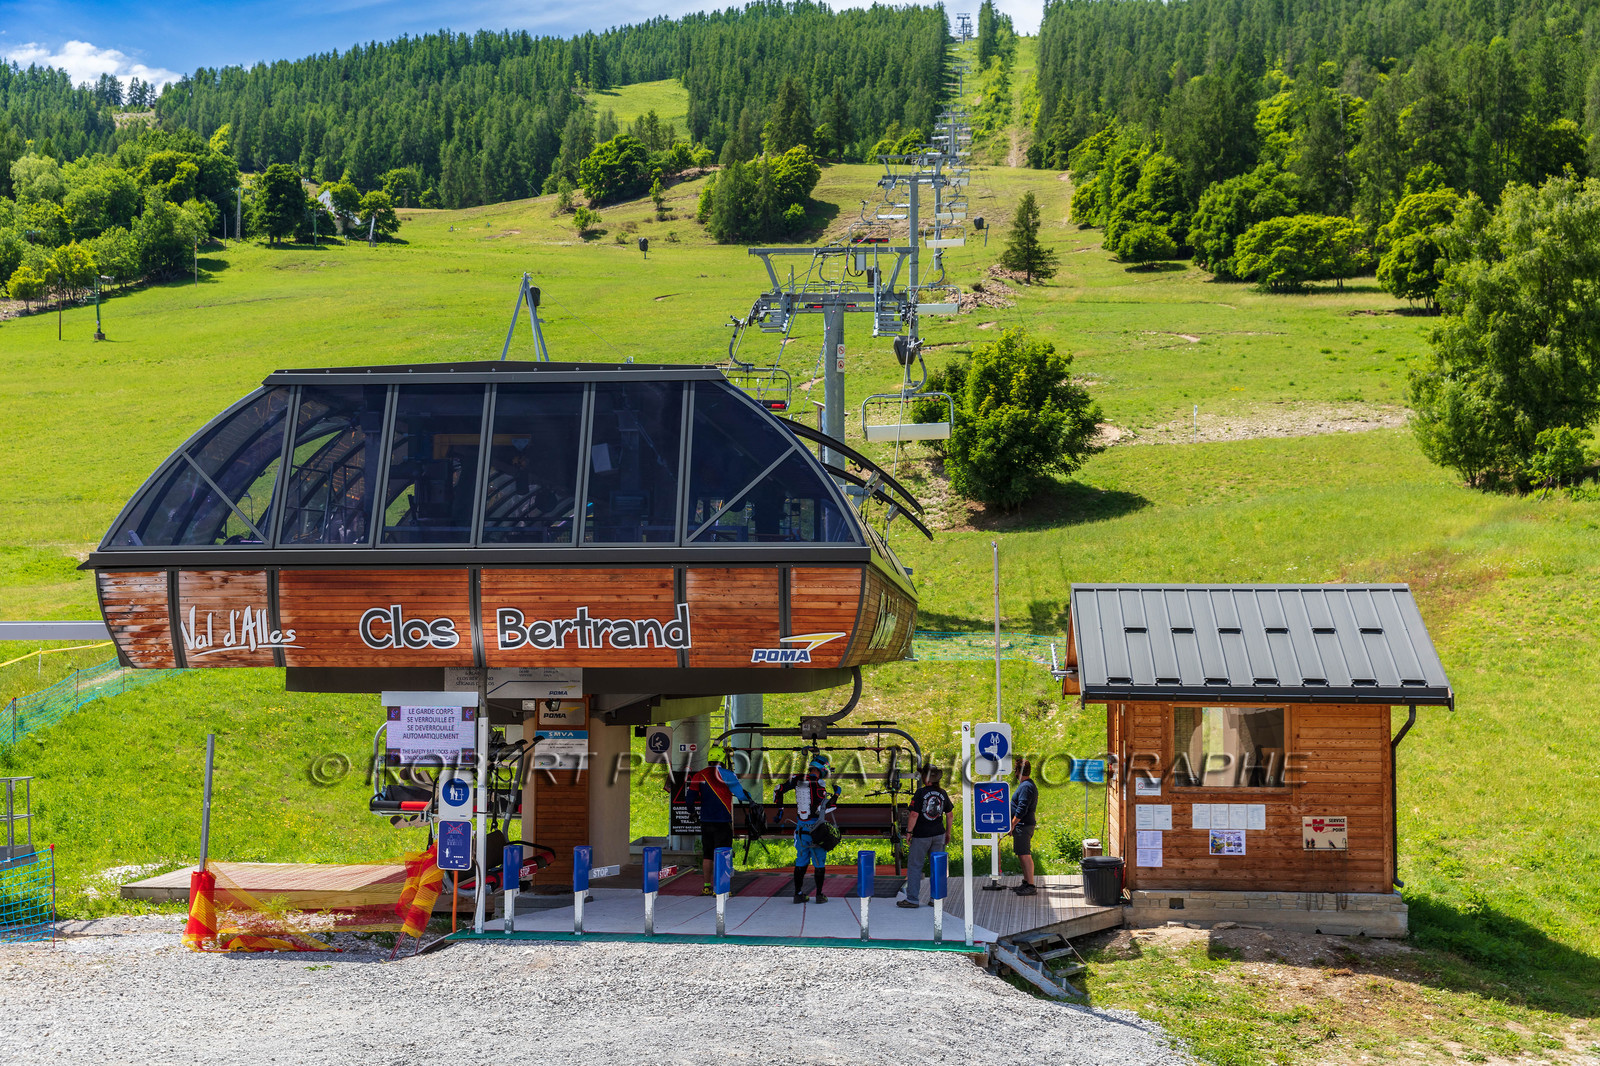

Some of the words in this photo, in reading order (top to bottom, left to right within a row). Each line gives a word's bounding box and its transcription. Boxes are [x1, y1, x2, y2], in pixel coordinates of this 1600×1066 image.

[180, 605, 213, 650] Val
[223, 605, 297, 652] d'Allos
[359, 604, 460, 650] Clos
[496, 602, 692, 650] Bertrand
[751, 648, 812, 663] POMA
[520, 866, 531, 877] STOP
[592, 868, 609, 878] STOP
